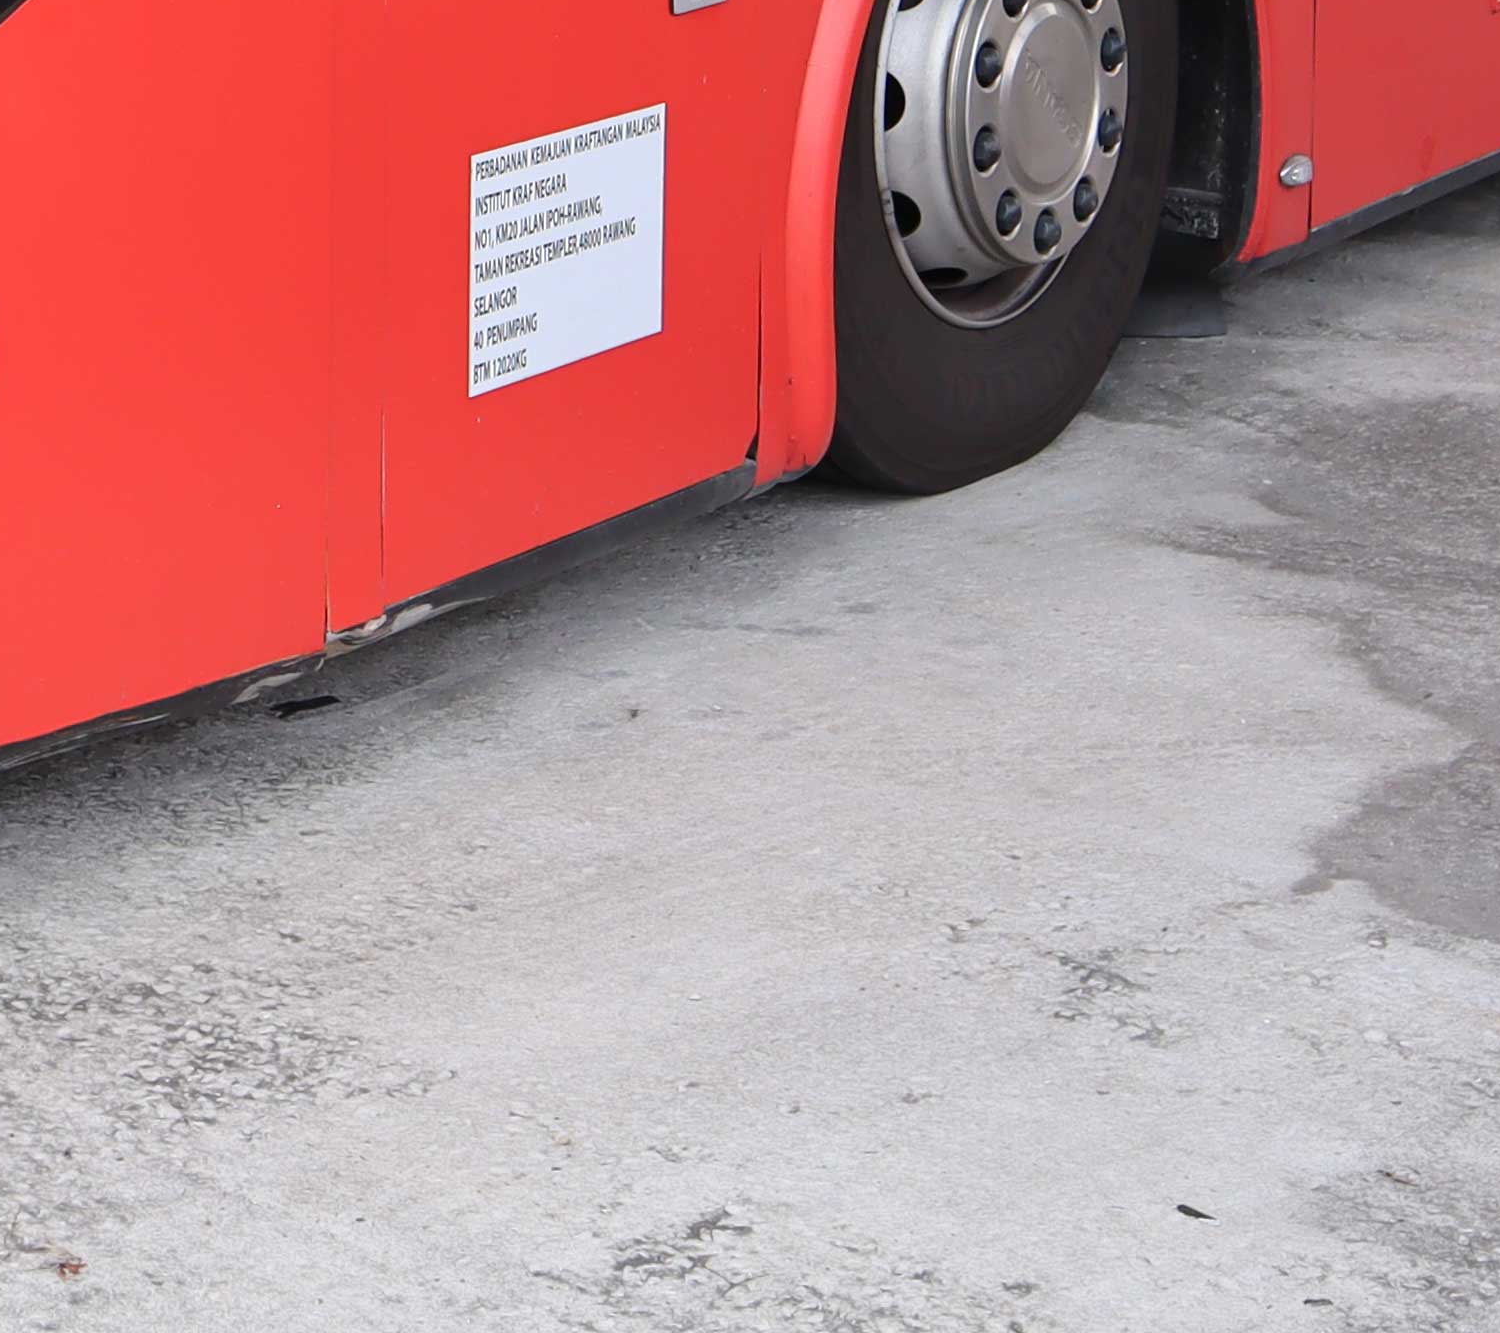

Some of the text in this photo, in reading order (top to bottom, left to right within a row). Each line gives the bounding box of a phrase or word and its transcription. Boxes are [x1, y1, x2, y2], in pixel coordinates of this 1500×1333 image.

[475, 113, 661, 181] PERBADANAN KEMAJUAN KRAFTANGAN MALAYSIA
[475, 173, 567, 217] INSTITUT KRAF NEGARA
[496, 220, 518, 245] KM20
[519, 212, 544, 239] JALAN
[475, 258, 503, 284] TAMAN
[505, 245, 542, 275] REKREASI
[602, 217, 636, 246] RAWANG
[474, 286, 517, 318] SELANGOR
[474, 312, 538, 350] 40 PENUMPANG
[473, 348, 527, 385] BTM 12020KG
